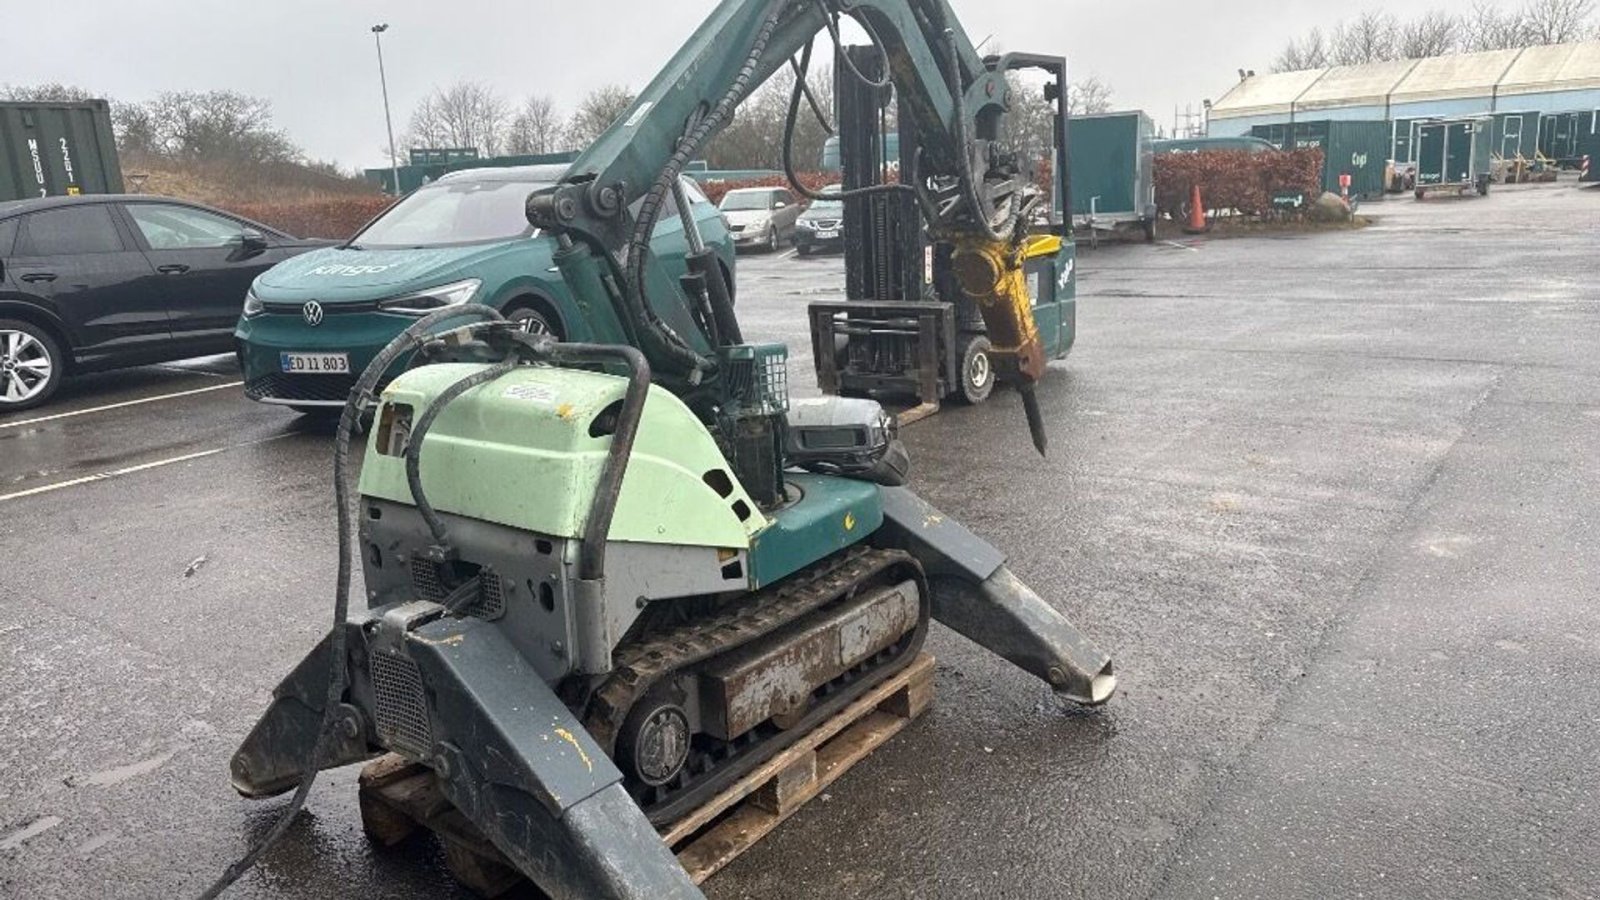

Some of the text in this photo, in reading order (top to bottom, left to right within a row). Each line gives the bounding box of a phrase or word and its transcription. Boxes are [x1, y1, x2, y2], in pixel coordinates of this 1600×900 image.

[289, 356, 347, 371] ED 11 803
